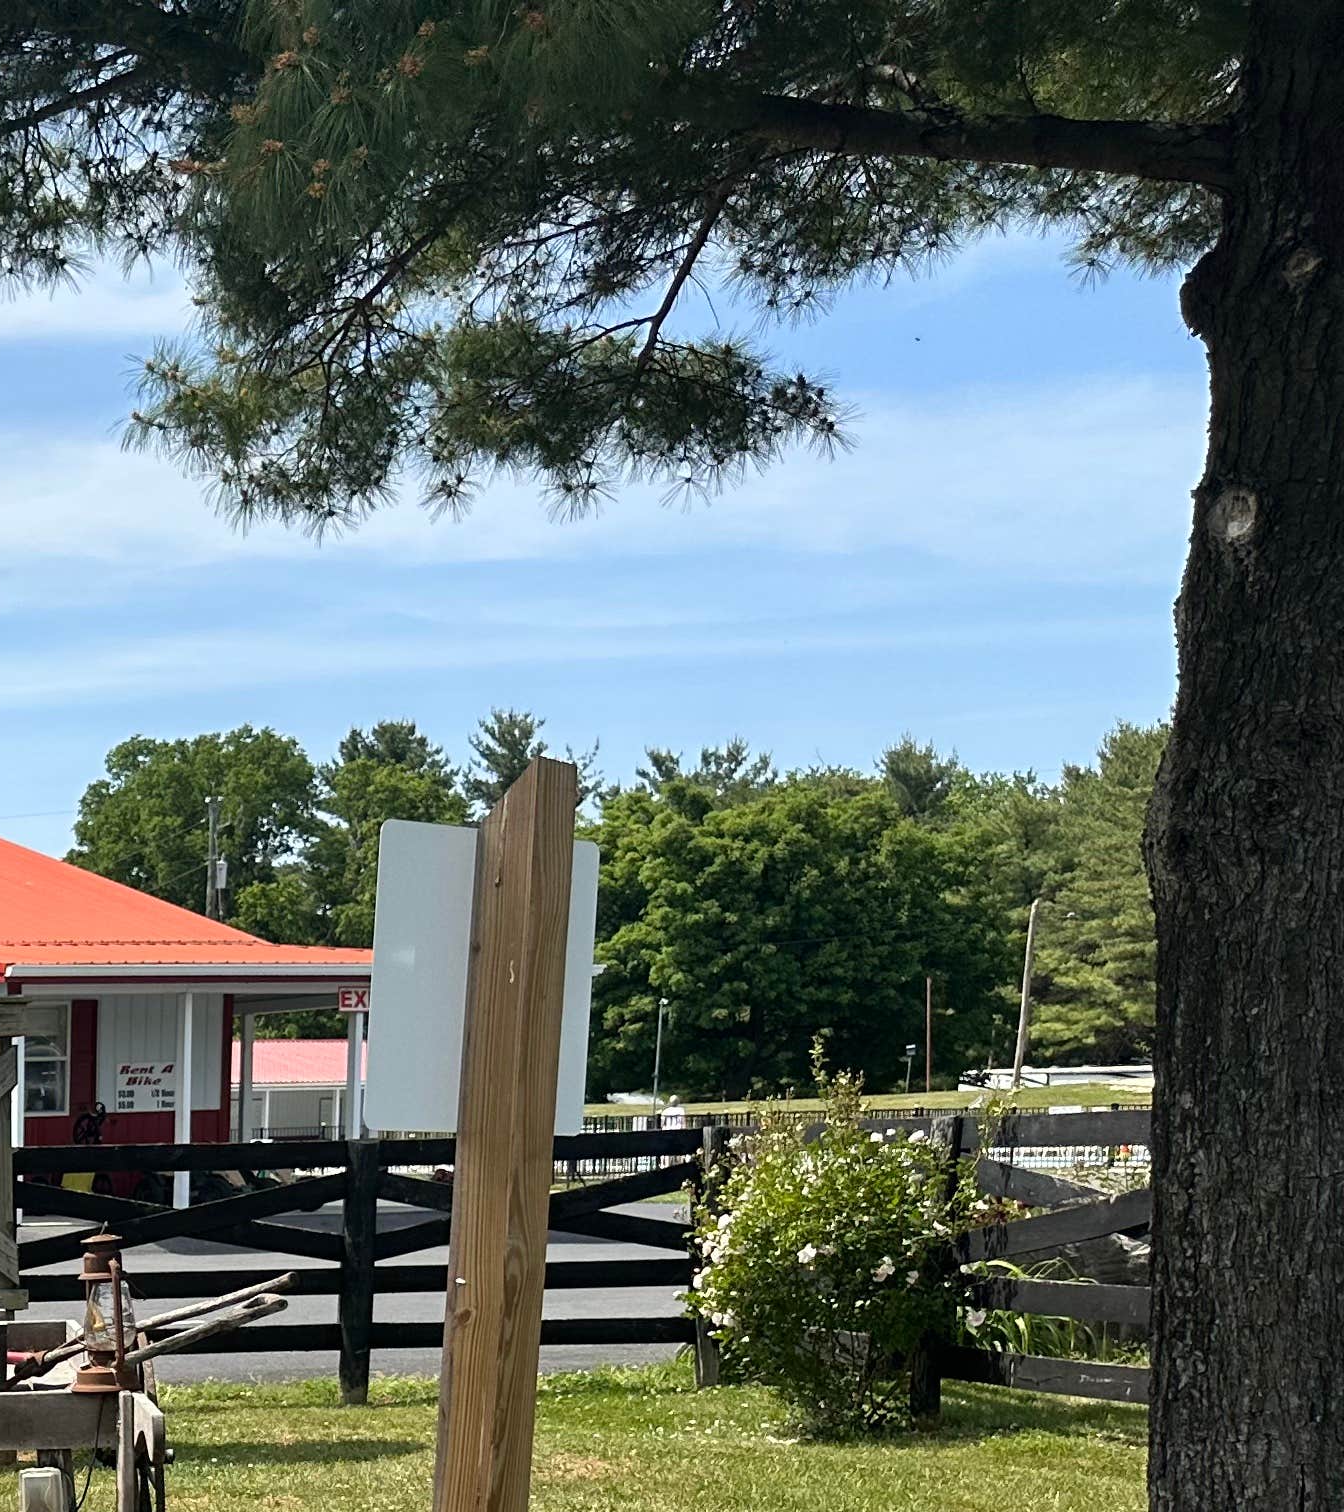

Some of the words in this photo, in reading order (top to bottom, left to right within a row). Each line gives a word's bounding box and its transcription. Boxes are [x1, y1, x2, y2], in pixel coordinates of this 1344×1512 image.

[341, 990, 368, 1009] EX
[120, 1065, 155, 1075] Rent
[161, 1064, 175, 1074] A
[126, 1076, 162, 1086] Bike
